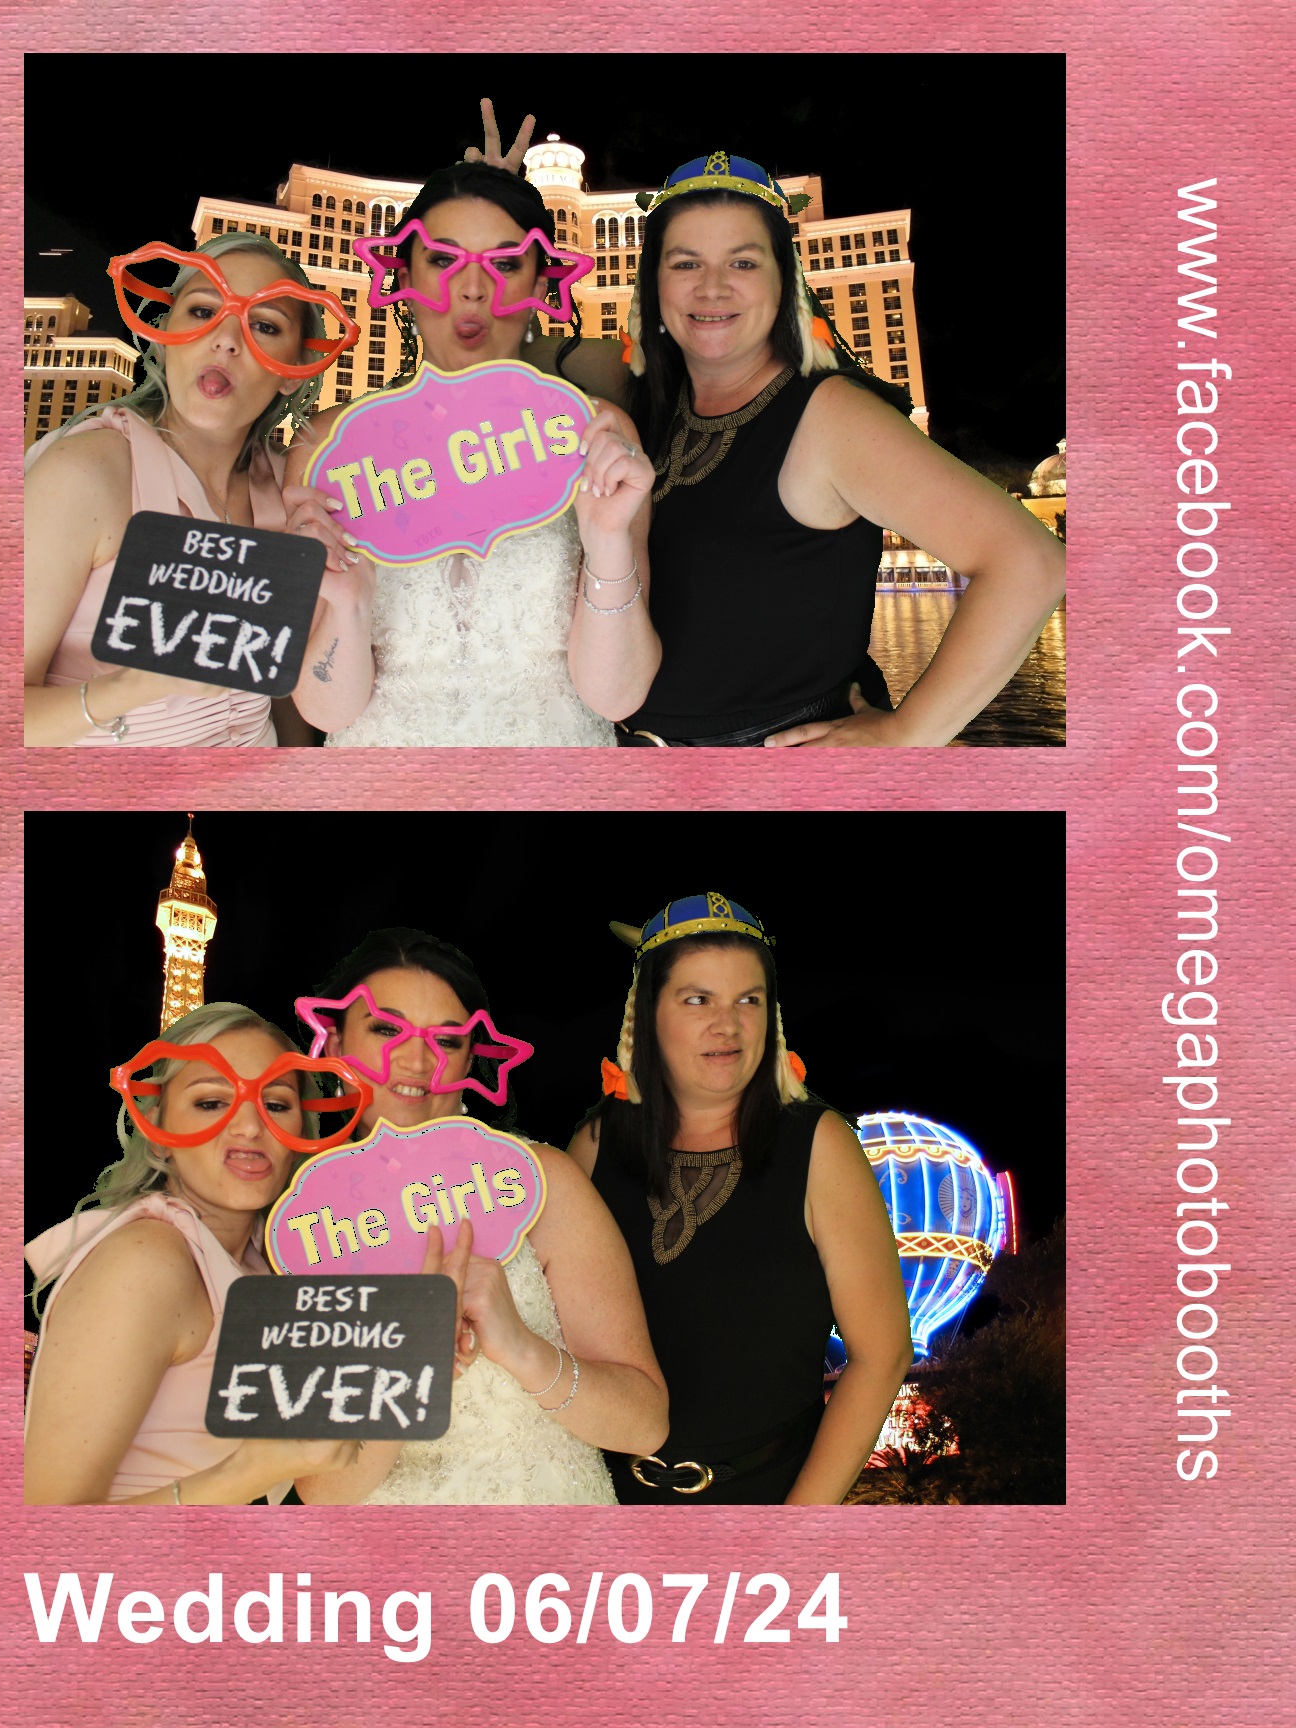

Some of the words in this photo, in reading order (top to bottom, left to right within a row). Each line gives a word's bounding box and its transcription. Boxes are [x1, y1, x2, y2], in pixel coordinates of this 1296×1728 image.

[327, 456, 437, 519] The
[448, 408, 582, 484] Girls
[182, 530, 257, 564] BEST
[106, 596, 292, 684] EVER!
[287, 1205, 391, 1266] The
[401, 1162, 527, 1234] Girls
[295, 1286, 380, 1312] BEST
[218, 1362, 435, 1428] EVER!
